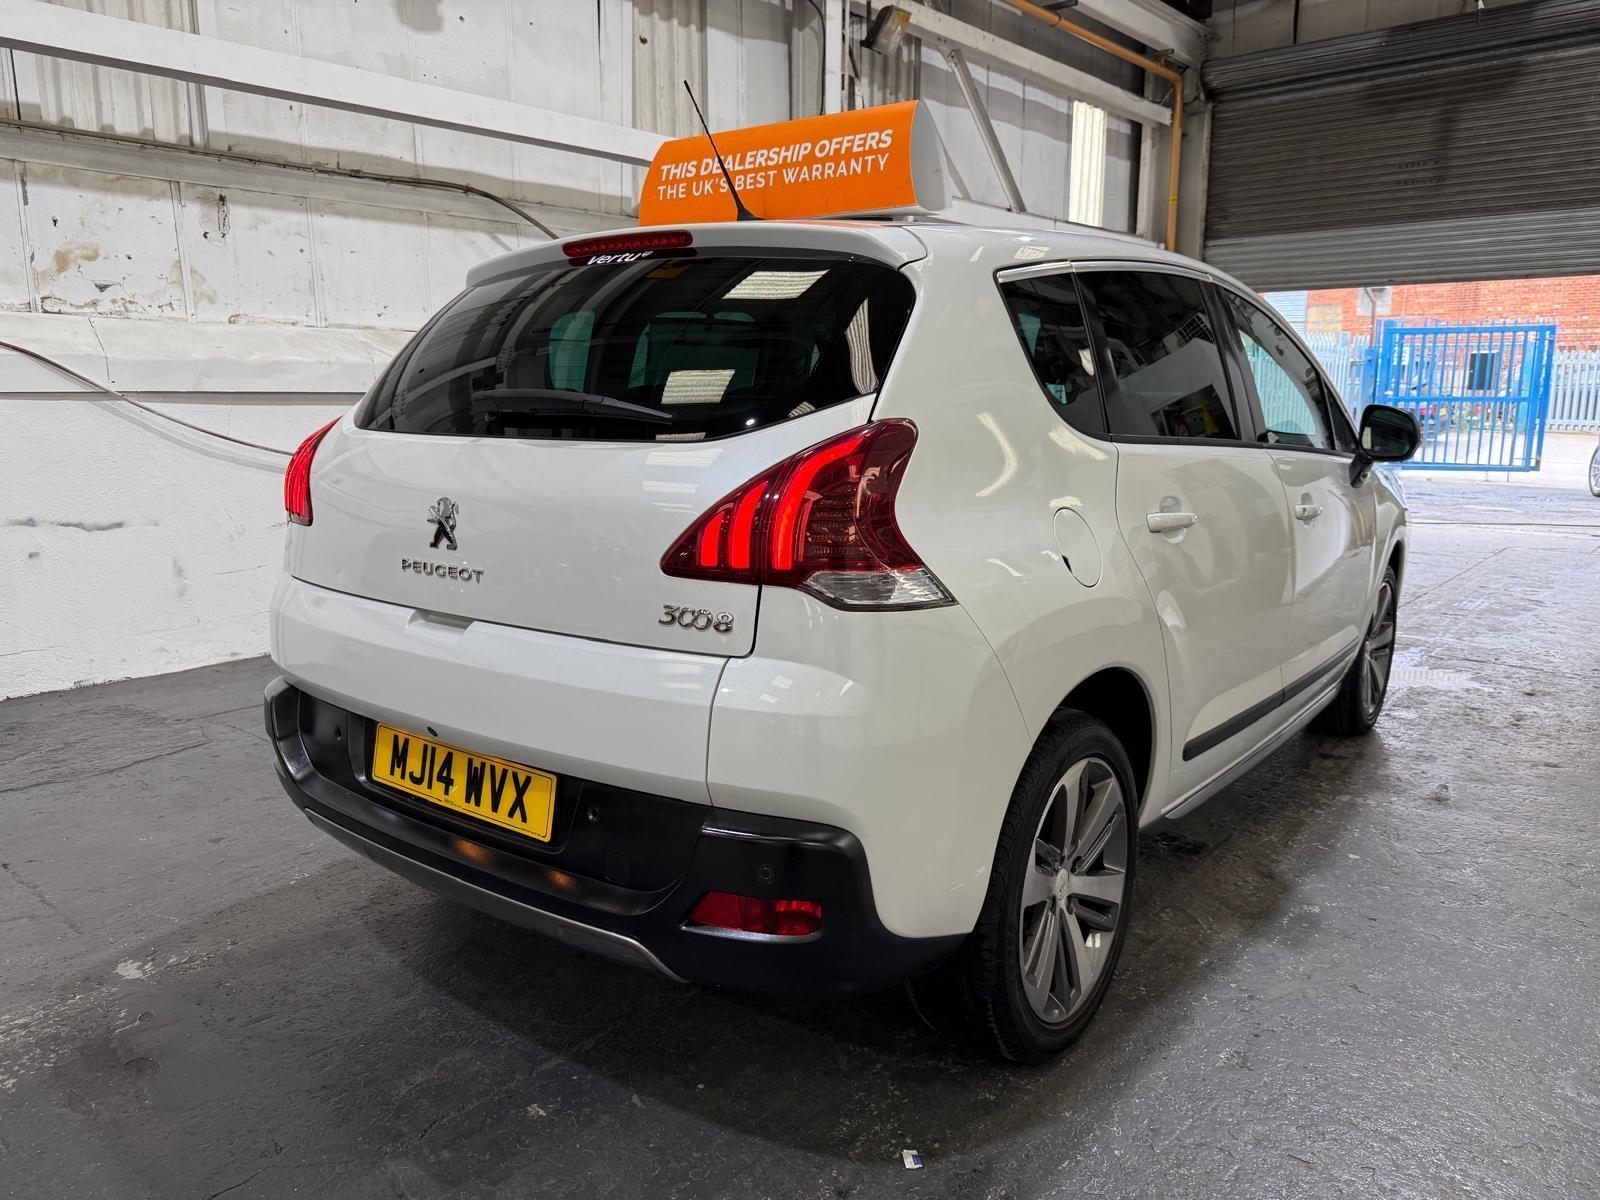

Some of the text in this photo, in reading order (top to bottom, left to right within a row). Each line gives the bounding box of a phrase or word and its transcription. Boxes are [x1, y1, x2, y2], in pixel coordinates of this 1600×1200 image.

[660, 129, 893, 181] THIS DEALERSHIP OFFERS
[657, 153, 889, 200] THE UK'S BEST WARRANTY
[587, 251, 642, 265] vertu
[401, 558, 484, 583] PEUGEOT
[658, 604, 734, 633] 3008
[389, 733, 532, 823] MJ14 WVX
